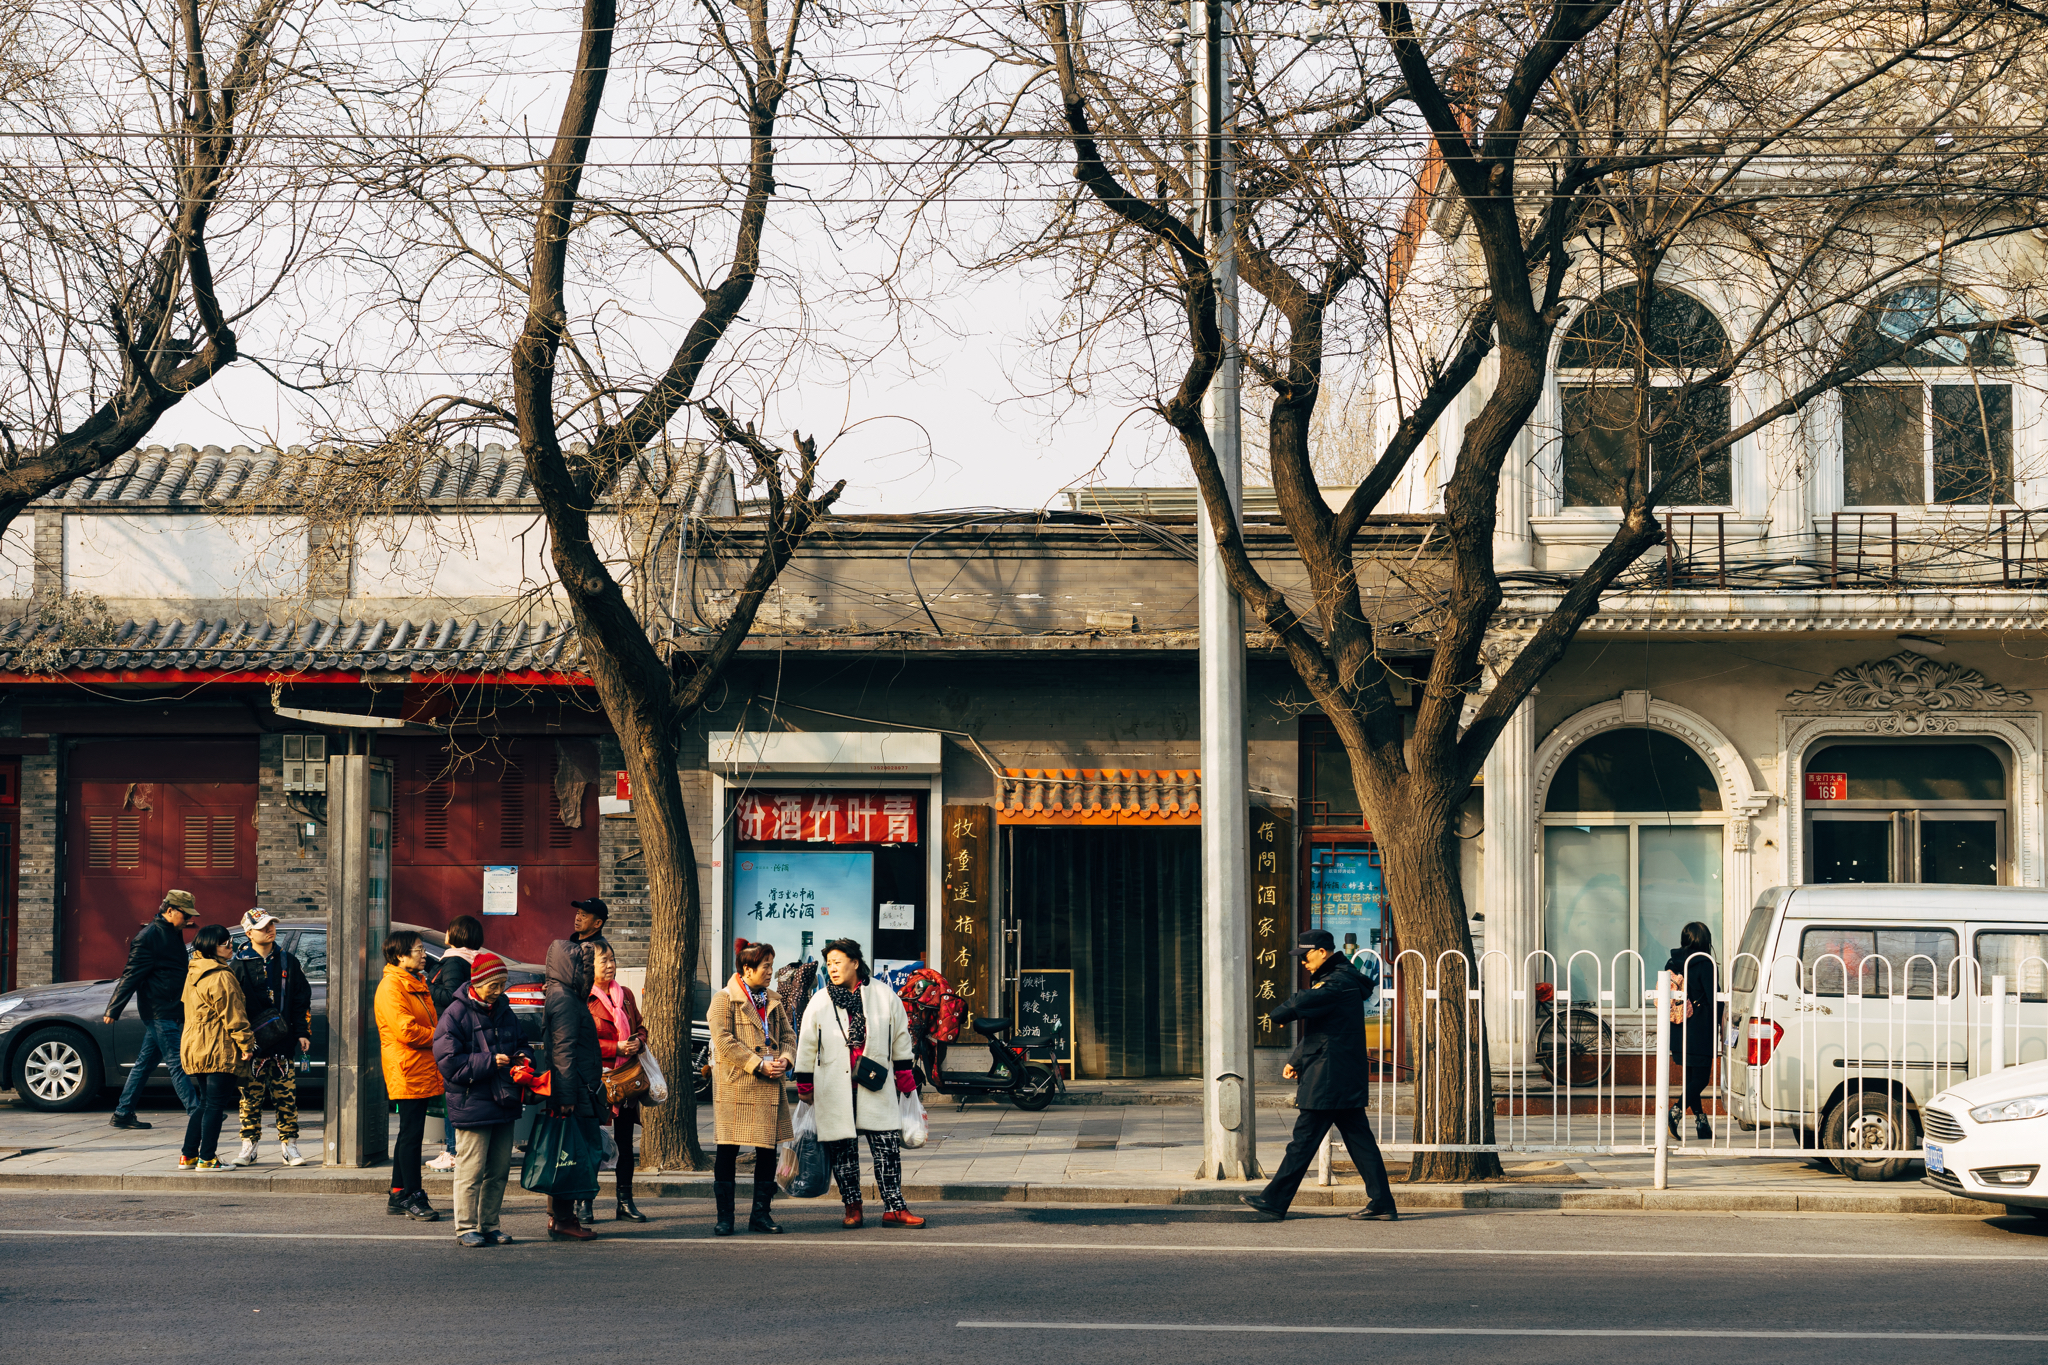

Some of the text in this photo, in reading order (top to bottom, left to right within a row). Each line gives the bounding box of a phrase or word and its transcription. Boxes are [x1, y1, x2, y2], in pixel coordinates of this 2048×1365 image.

[1808, 774, 1843, 782] 西安门大街
[1818, 786, 1836, 799] 169
[736, 794, 913, 842] 汾酒竹叶青
[747, 901, 815, 921] 青花汾酒
[1022, 975, 1046, 990] 饮料
[1040, 990, 1059, 1003] 特产
[1022, 1000, 1041, 1014] 零食
[1042, 1013, 1061, 1024] 礼品
